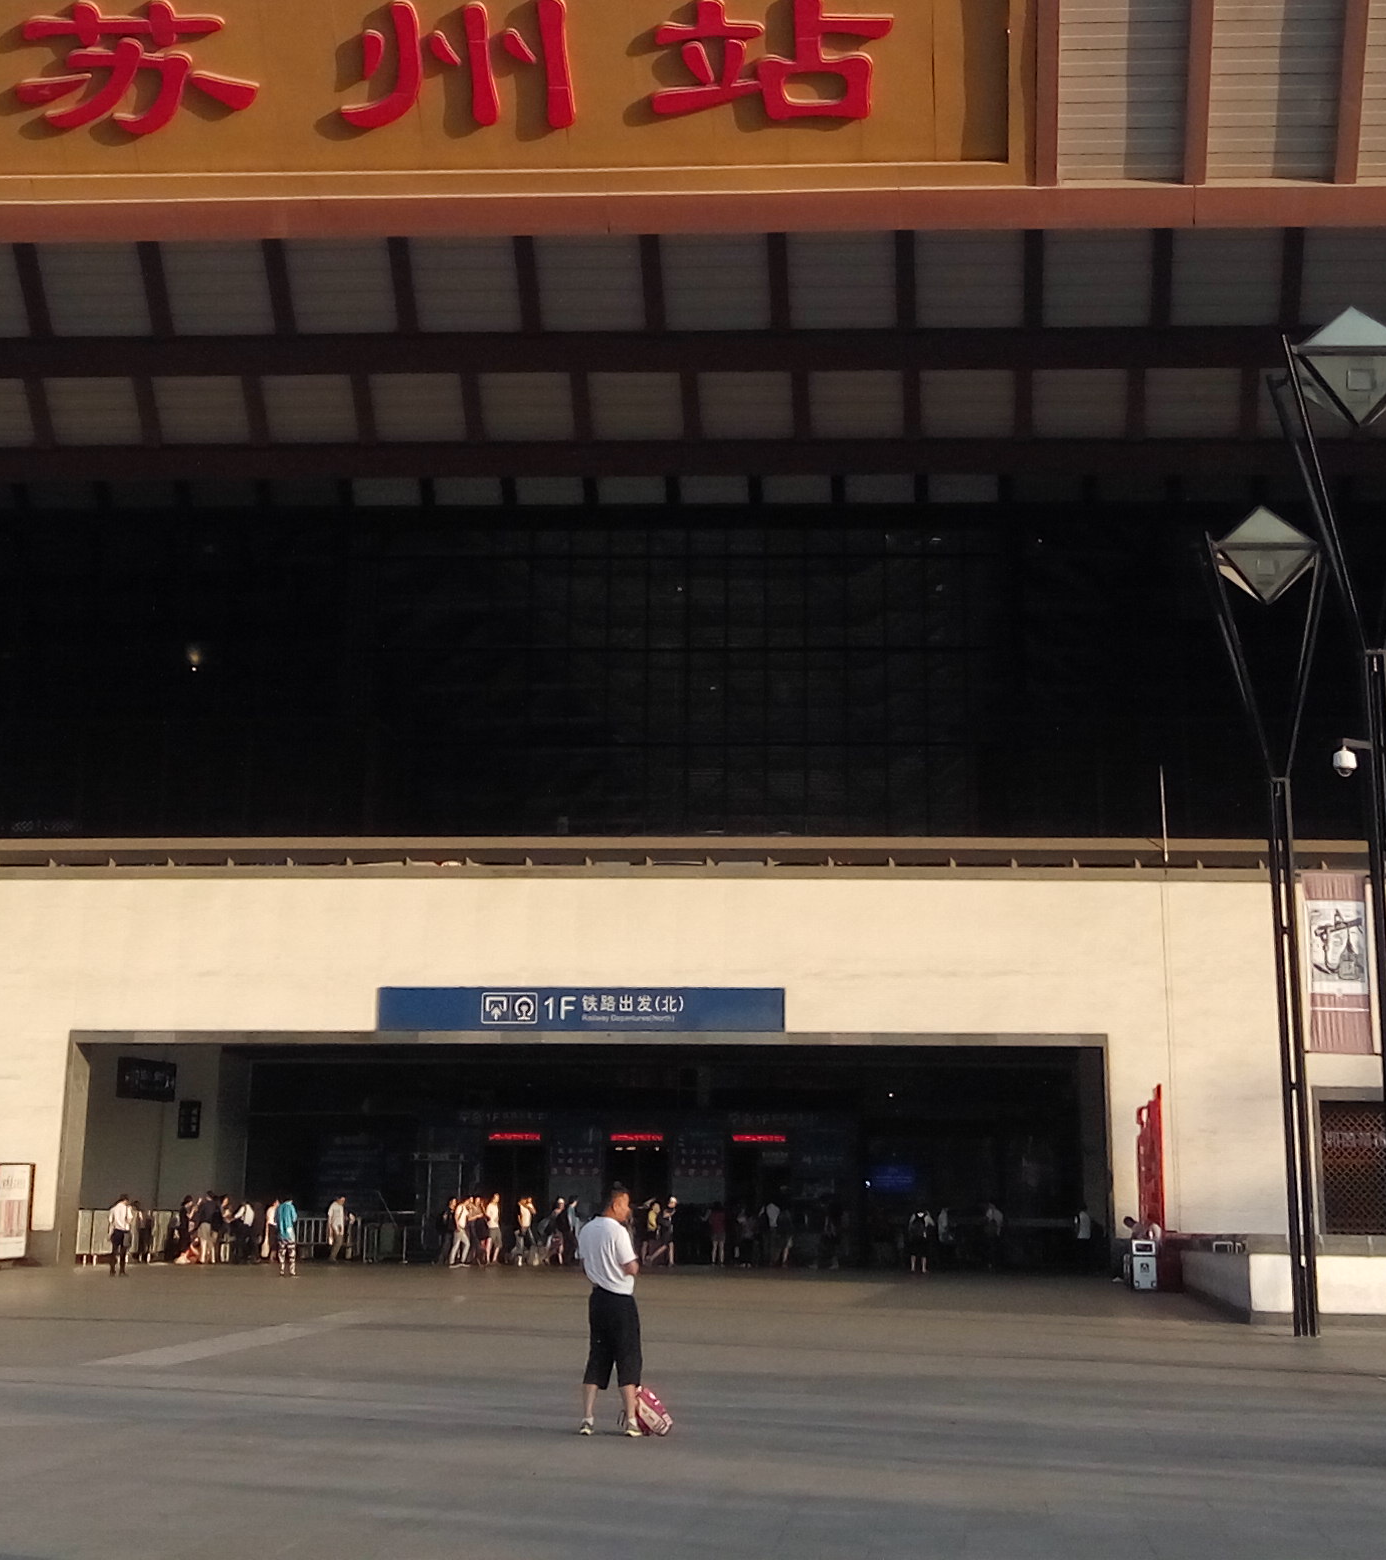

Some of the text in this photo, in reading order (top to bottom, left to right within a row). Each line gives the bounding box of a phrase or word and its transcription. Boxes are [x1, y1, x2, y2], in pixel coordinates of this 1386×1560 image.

[543, 994, 684, 1020] 1F 铁路出发(北)
